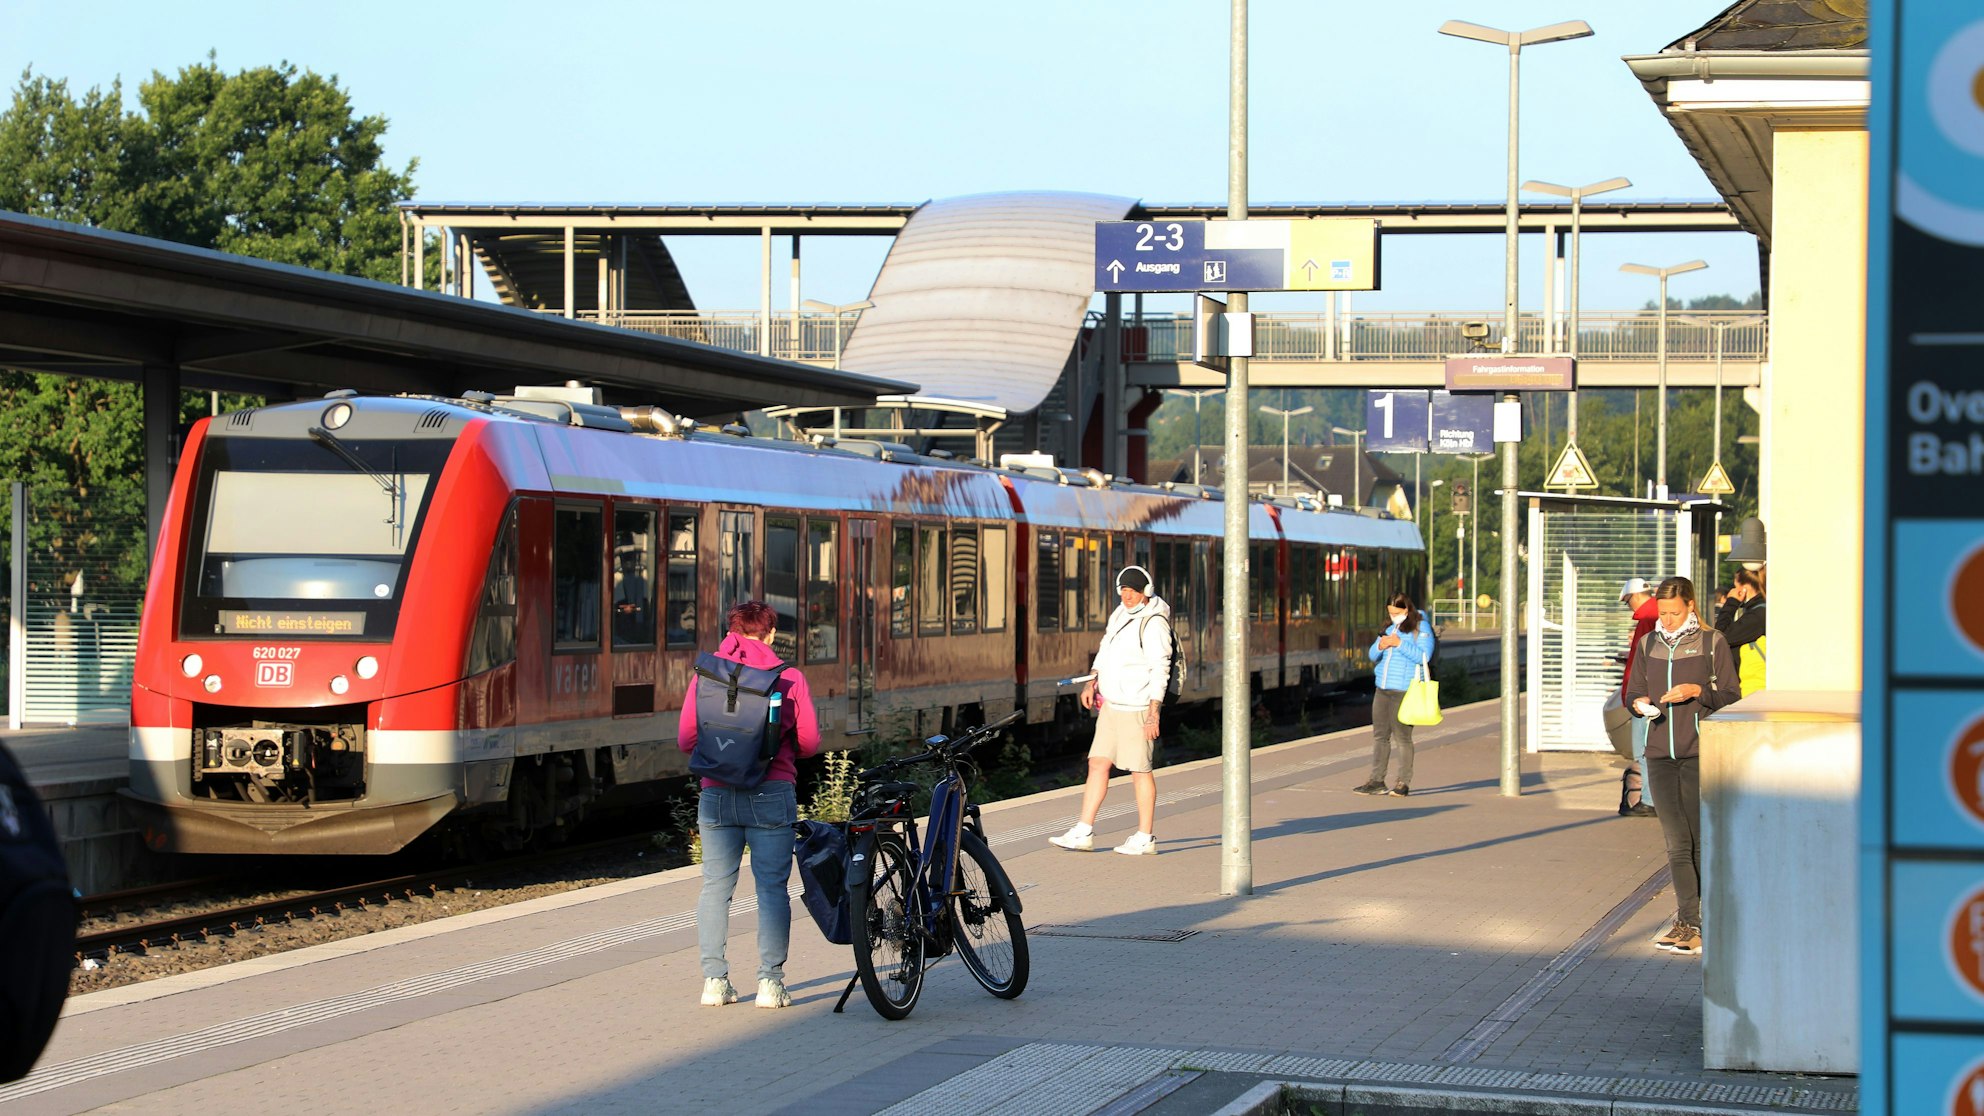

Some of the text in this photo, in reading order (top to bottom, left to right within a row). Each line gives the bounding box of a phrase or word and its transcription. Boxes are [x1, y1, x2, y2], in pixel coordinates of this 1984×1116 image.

[1135, 223, 1184, 251] 2-3
[1135, 261, 1181, 274] Ausgang
[1472, 364, 1545, 374] Fahrgastinformation
[1374, 392, 1394, 439] 1
[1439, 429, 1475, 441] Richtung
[1439, 438, 1459, 448] Köln
[235, 615, 351, 634] Nicht einsteigen
[253, 647, 301, 659] 620 027
[261, 666, 290, 683] DB
[556, 663, 598, 693] vareo
